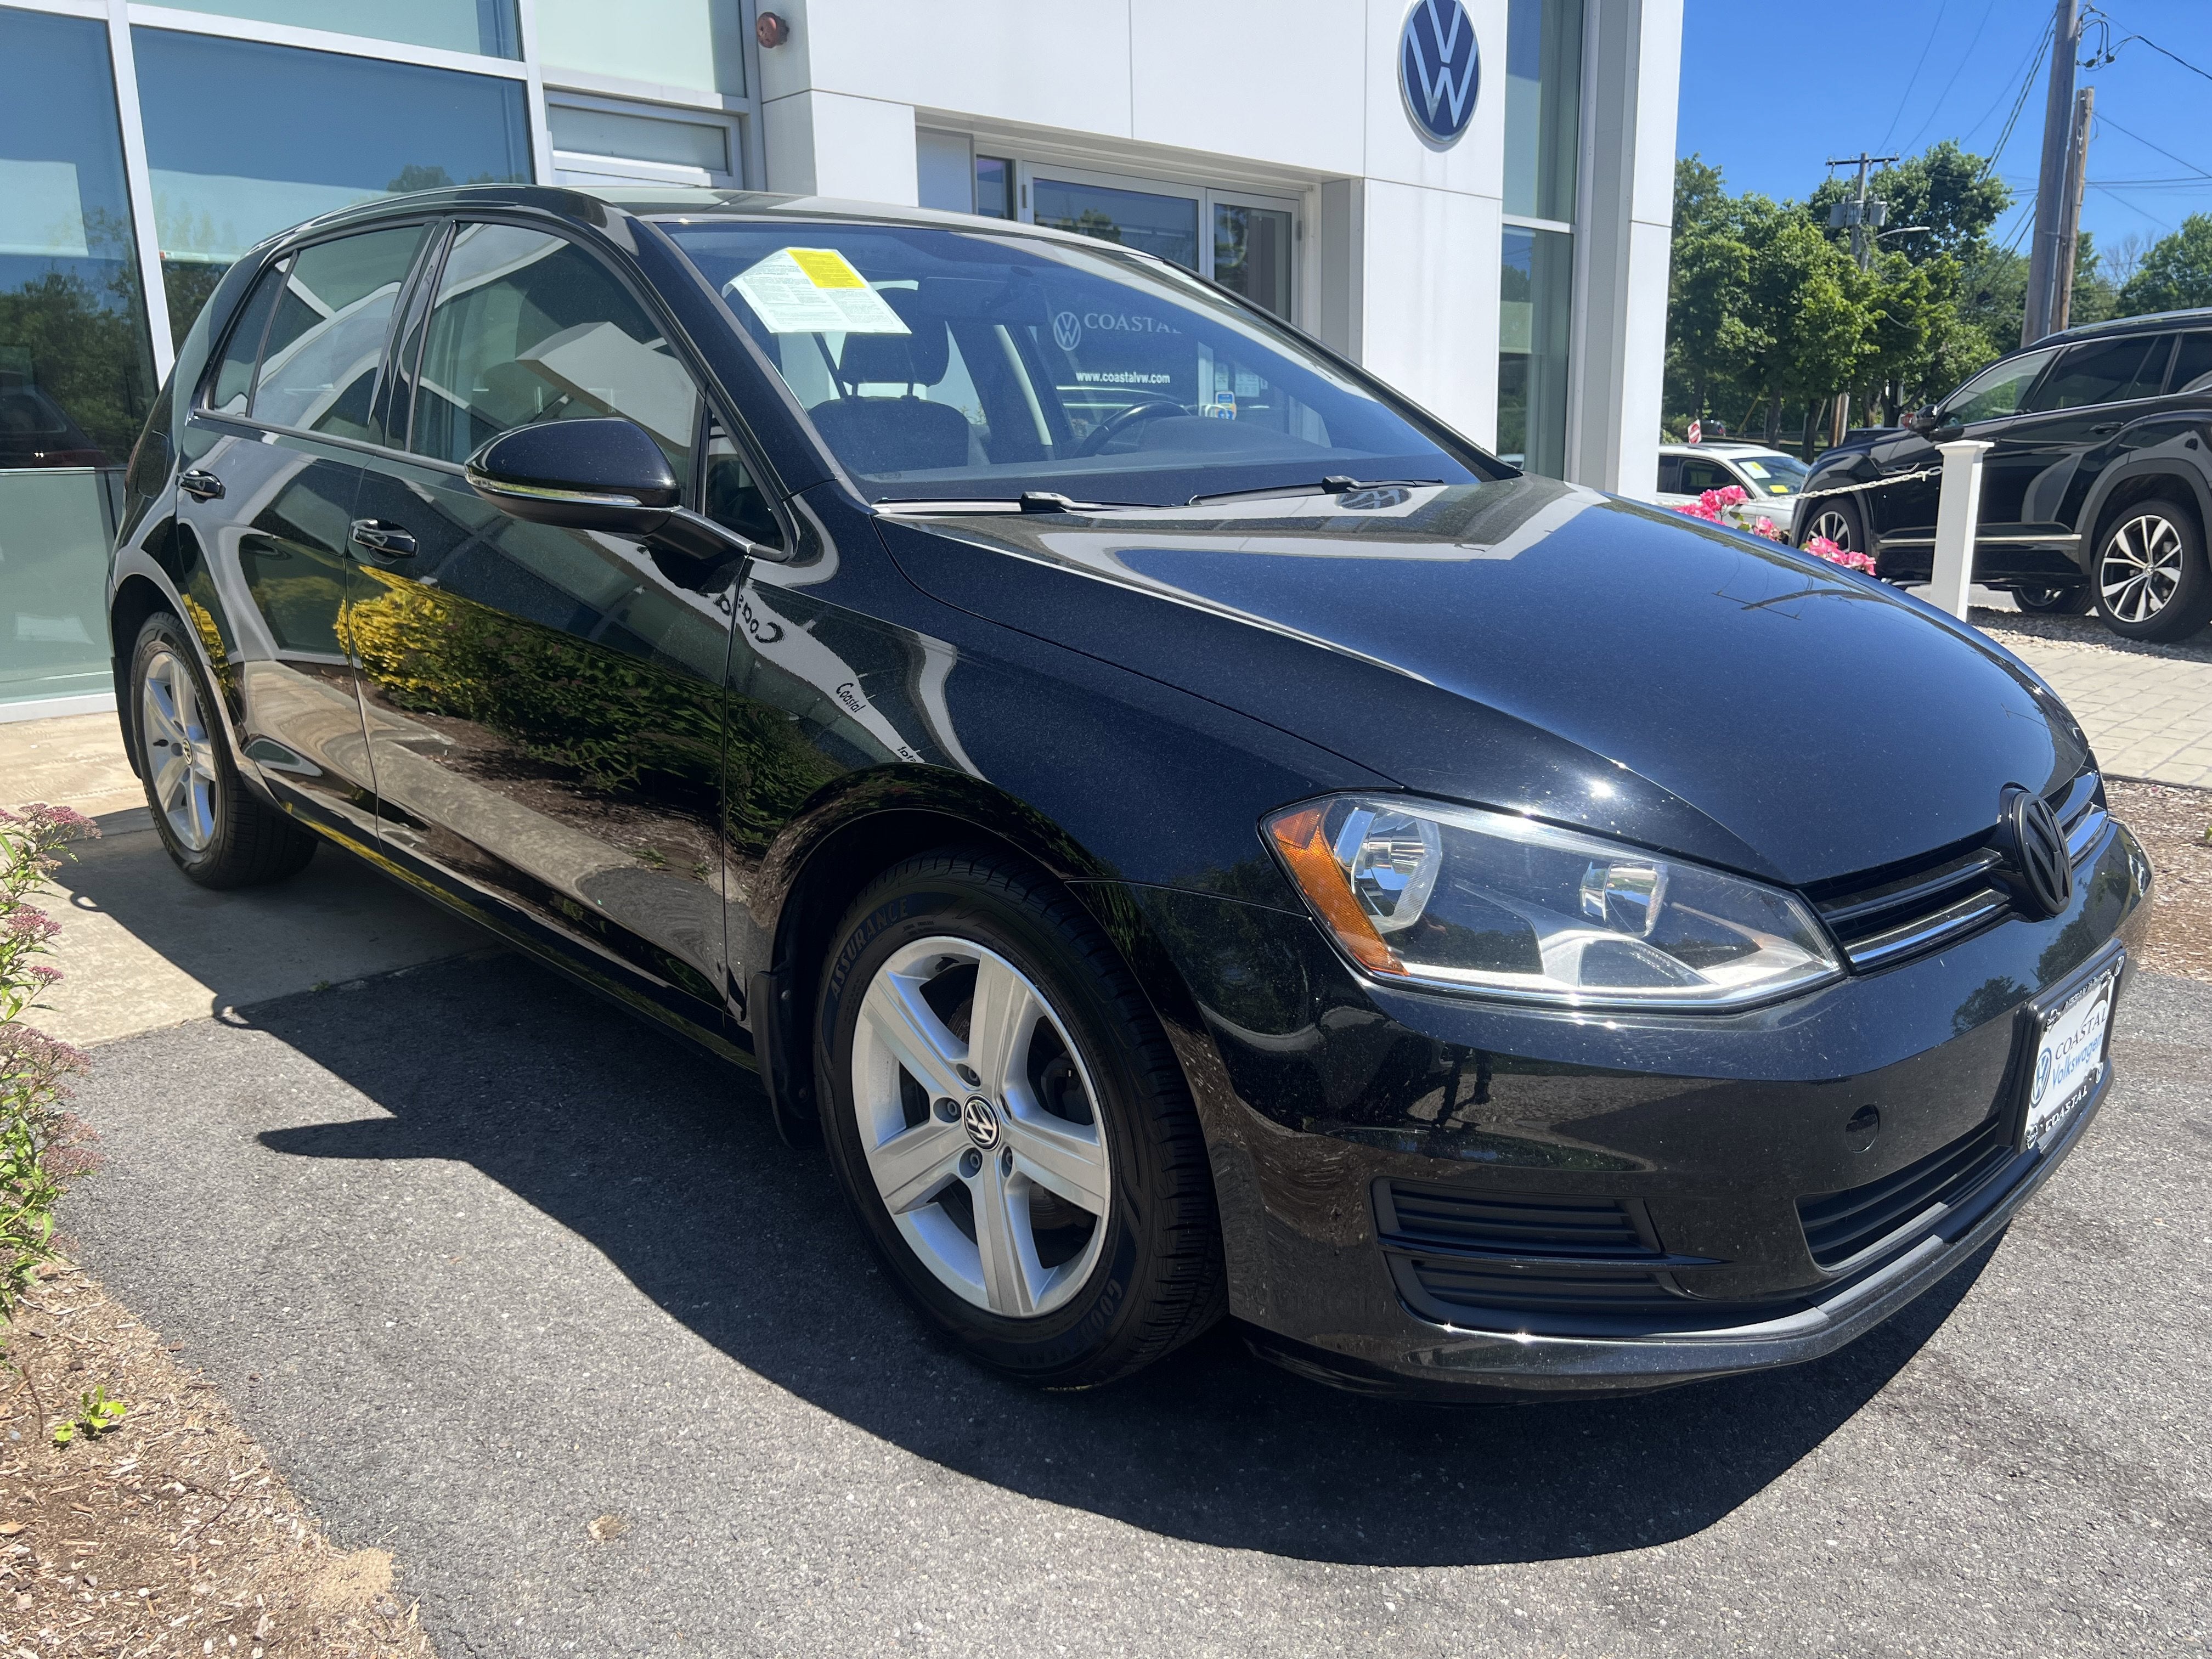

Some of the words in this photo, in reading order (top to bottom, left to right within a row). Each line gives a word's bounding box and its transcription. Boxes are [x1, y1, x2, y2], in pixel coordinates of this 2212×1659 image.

[1399, 0, 1481, 143] VW
[1053, 312, 1081, 351] VW
[1084, 313, 1182, 334] COASTA
[1076, 370, 1170, 383] www.coastalvw.com
[836, 682, 866, 713] Coastal
[2009, 792, 2072, 915] VW
[830, 898, 909, 1001] ASSURANCE
[2052, 1032, 2102, 1090] Volkswagen
[2055, 1007, 2107, 1060] COASTAL
[963, 1093, 1002, 1152] VW
[2045, 1085, 2087, 1132] COASTAL
